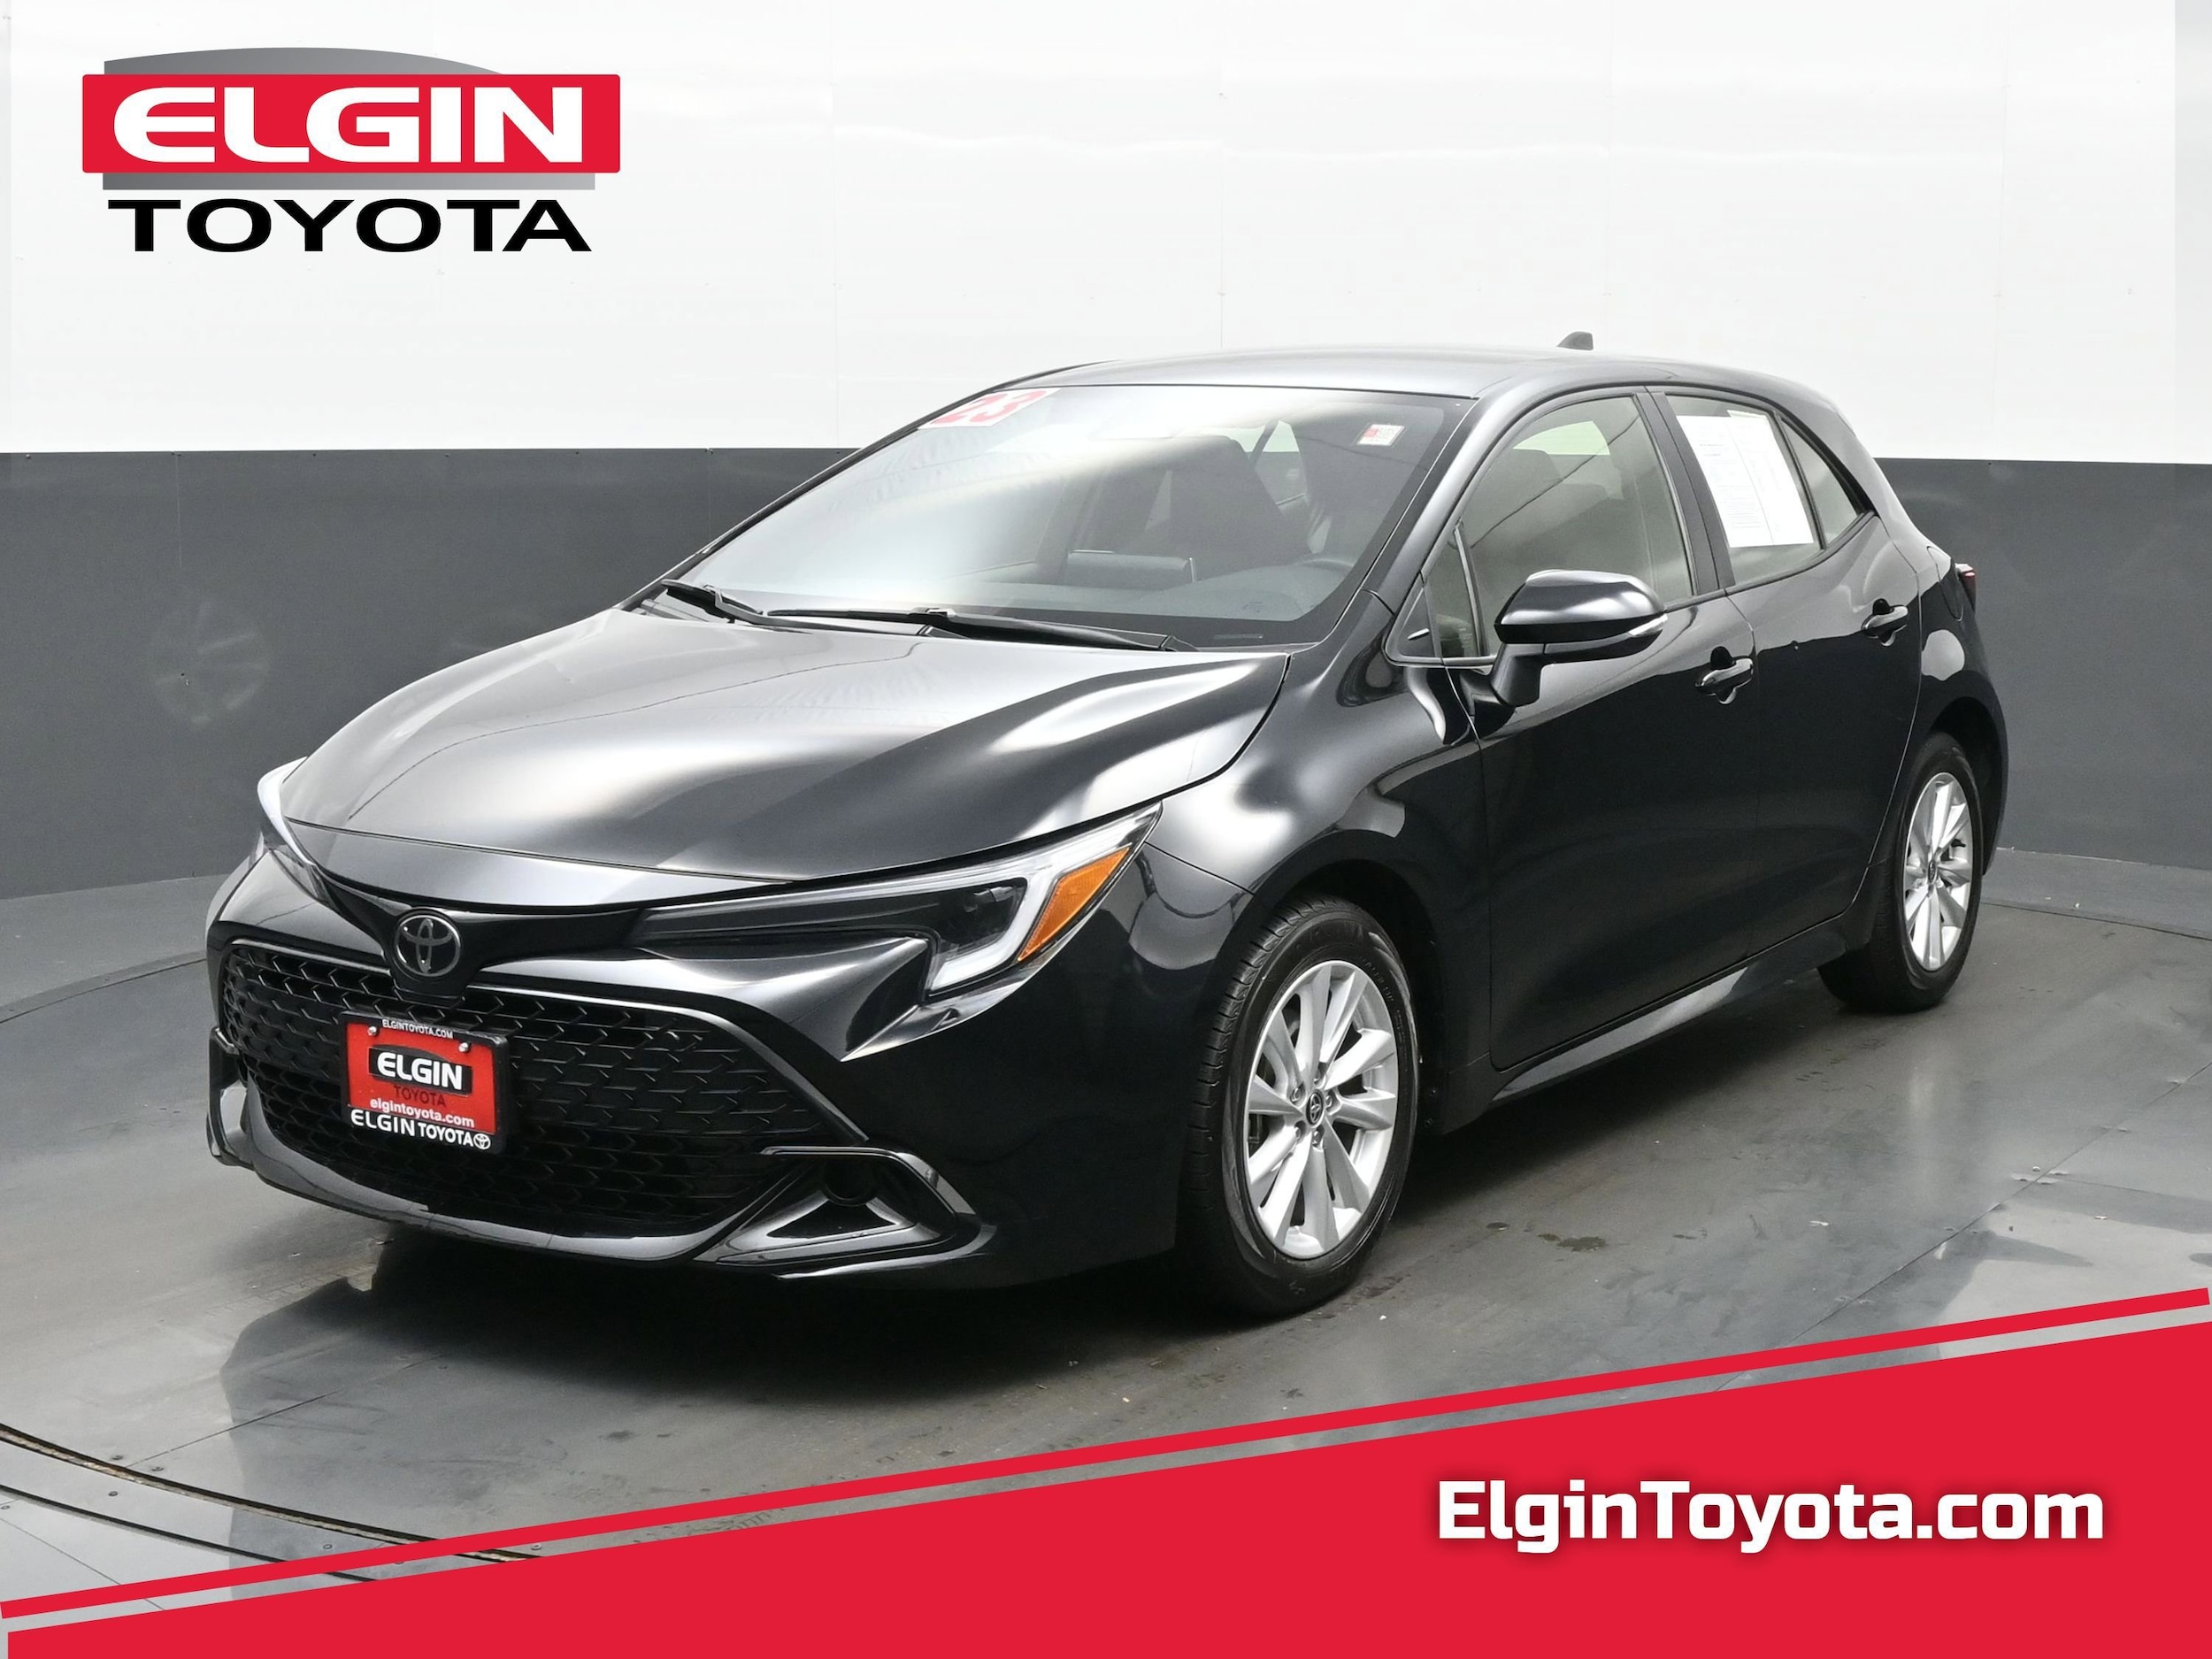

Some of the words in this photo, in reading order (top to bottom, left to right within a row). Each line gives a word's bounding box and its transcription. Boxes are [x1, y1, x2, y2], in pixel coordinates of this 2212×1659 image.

[382, 1019, 454, 1039] ELGINTOYOTA.COM
[377, 1052, 463, 1090] ELGIN
[394, 1085, 446, 1107] TOYOTA
[351, 1109, 416, 1137] ELGIN
[418, 1122, 473, 1147] TOYOTA
[370, 1098, 475, 1128] elgintoyota.com
